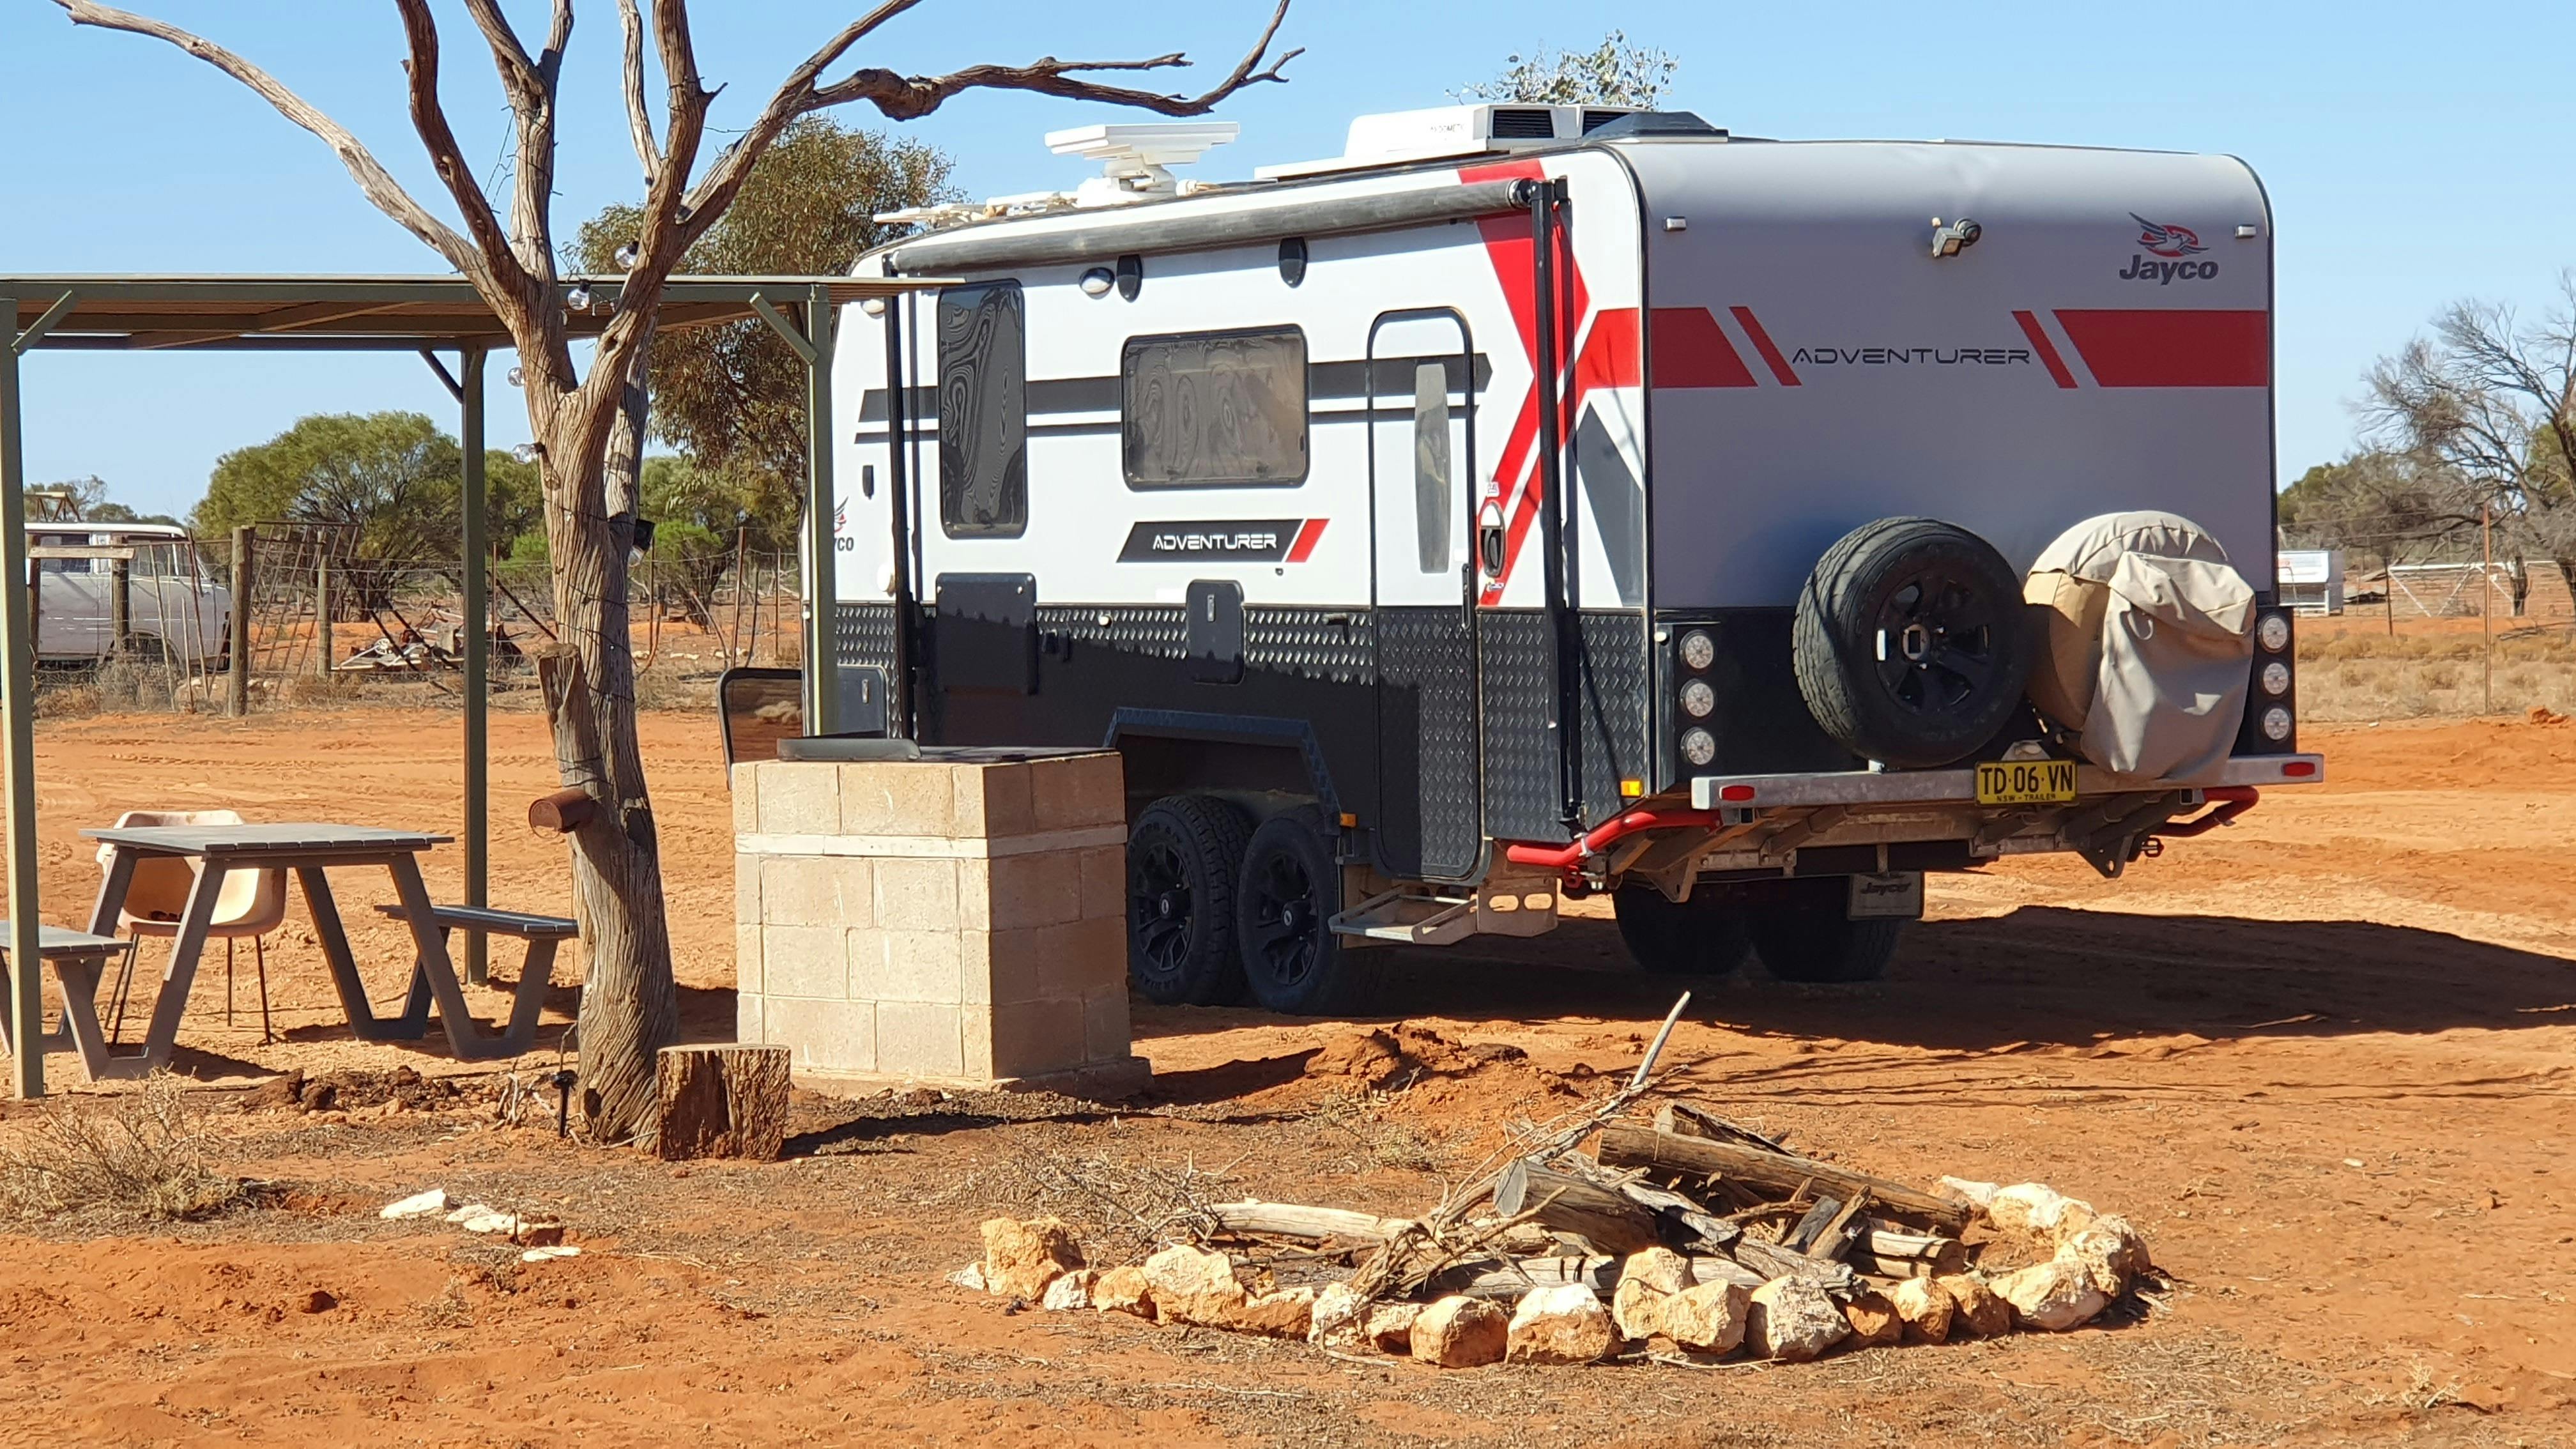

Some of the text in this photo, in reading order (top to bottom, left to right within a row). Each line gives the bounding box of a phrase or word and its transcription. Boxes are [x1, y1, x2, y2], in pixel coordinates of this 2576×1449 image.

[2119, 254, 2219, 286] Jayco
[1792, 348, 2030, 364] ADVENTURER
[1153, 533, 1276, 551] ADVENTURER
